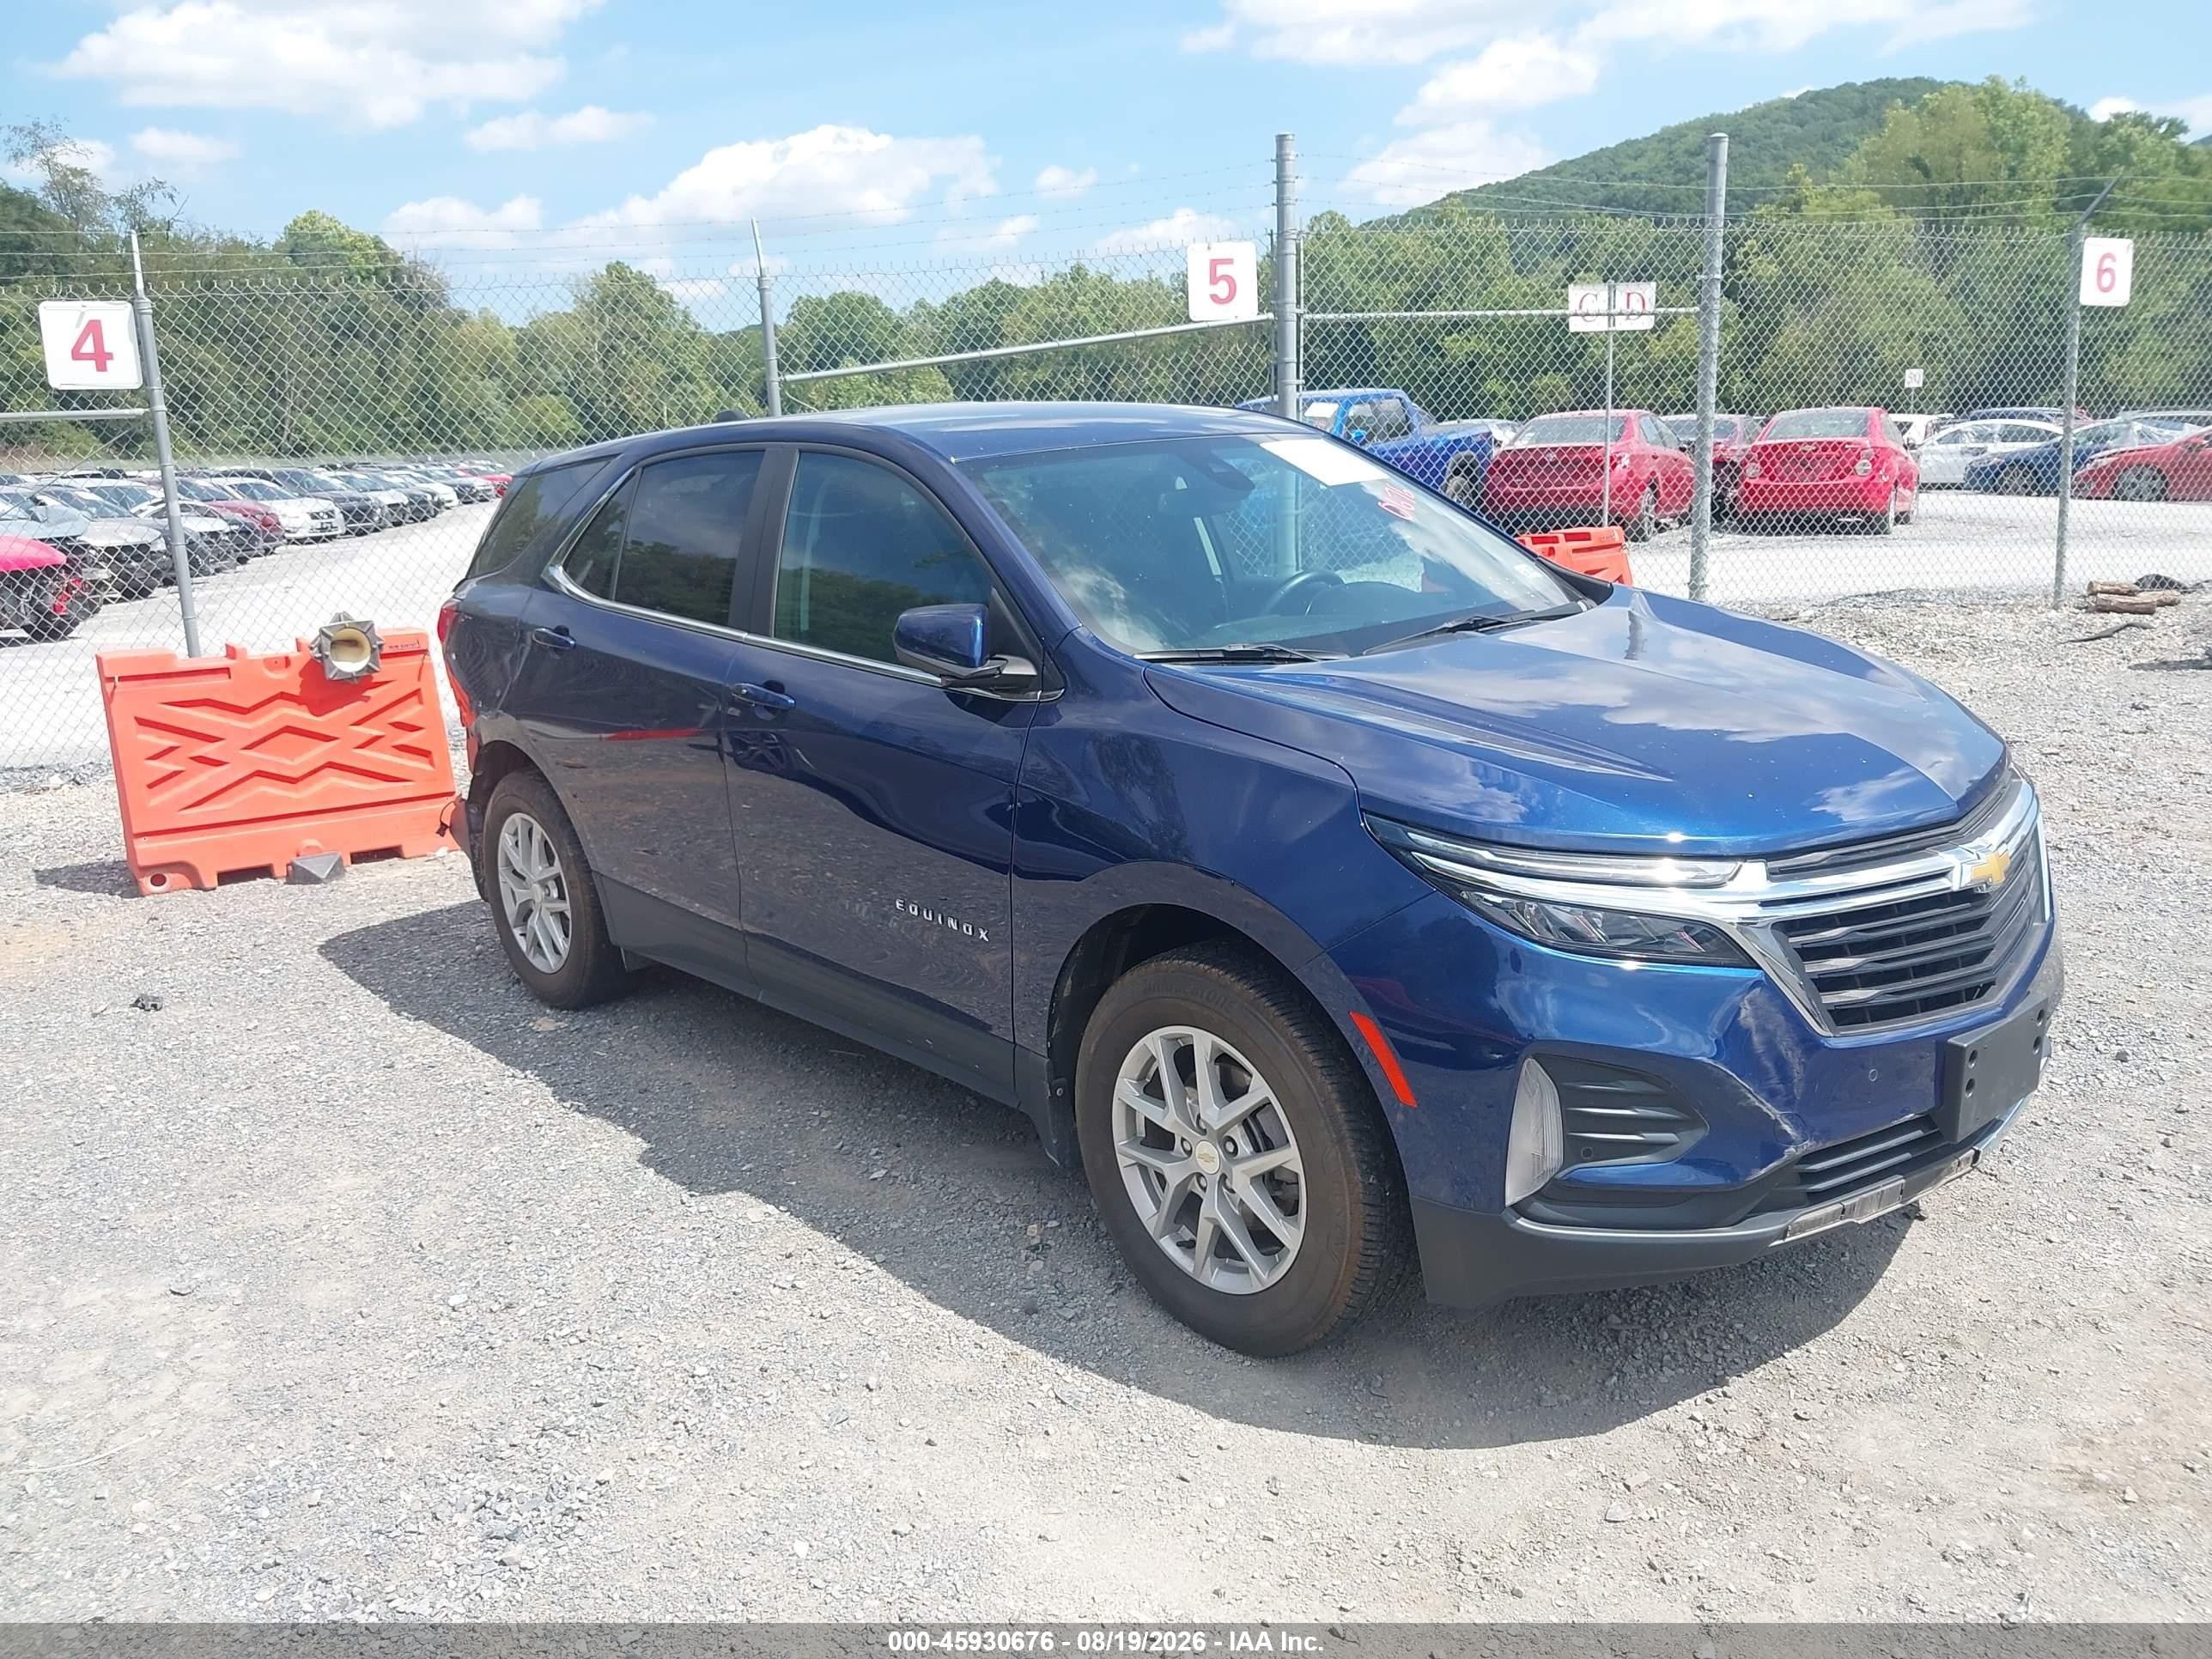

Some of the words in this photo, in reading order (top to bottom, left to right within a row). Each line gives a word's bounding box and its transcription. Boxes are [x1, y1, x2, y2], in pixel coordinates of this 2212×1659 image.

[1209, 258, 1237, 305] 5
[2096, 252, 2117, 294] 6
[1578, 292, 1598, 323] C
[1626, 290, 1646, 321] D
[70, 319, 114, 373] 4
[895, 897, 990, 943] EQUINOX
